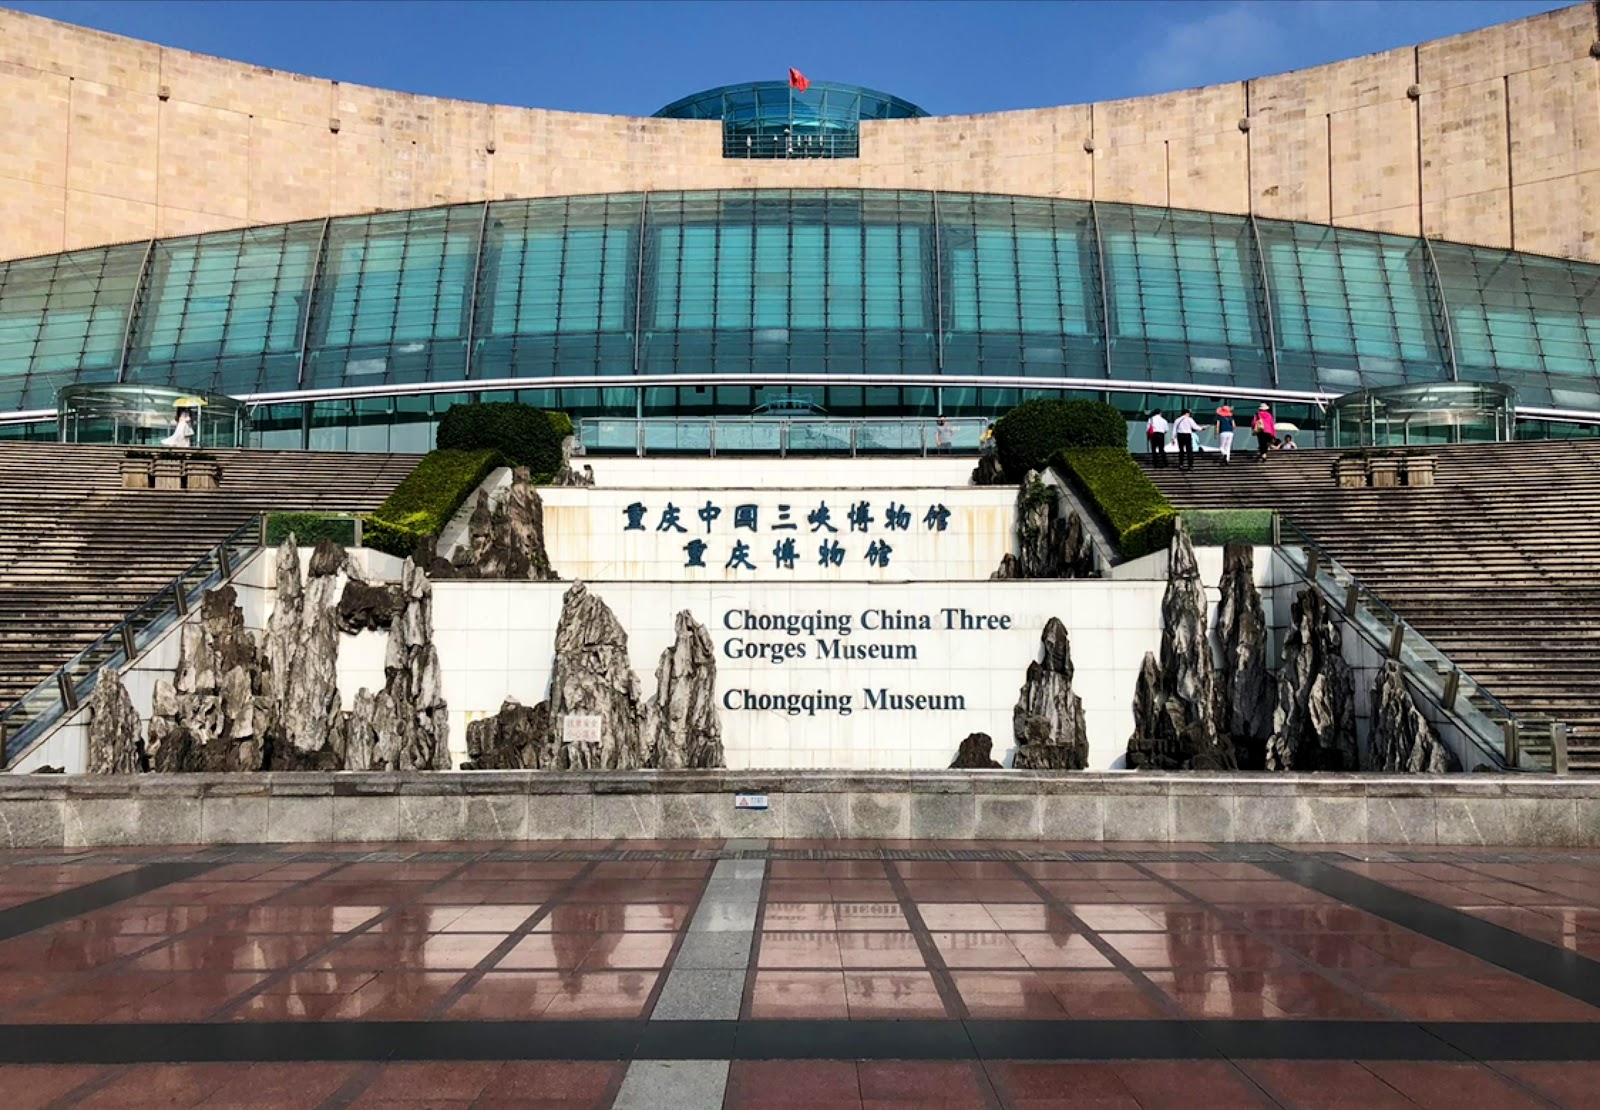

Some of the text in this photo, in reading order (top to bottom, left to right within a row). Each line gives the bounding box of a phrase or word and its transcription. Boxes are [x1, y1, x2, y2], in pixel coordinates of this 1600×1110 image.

[682, 537, 893, 571] 重庆博物馆
[723, 608, 1011, 636] Chongqing China Three
[723, 639, 918, 663] Gorges Museum
[723, 688, 966, 716] Chongqing Museum
